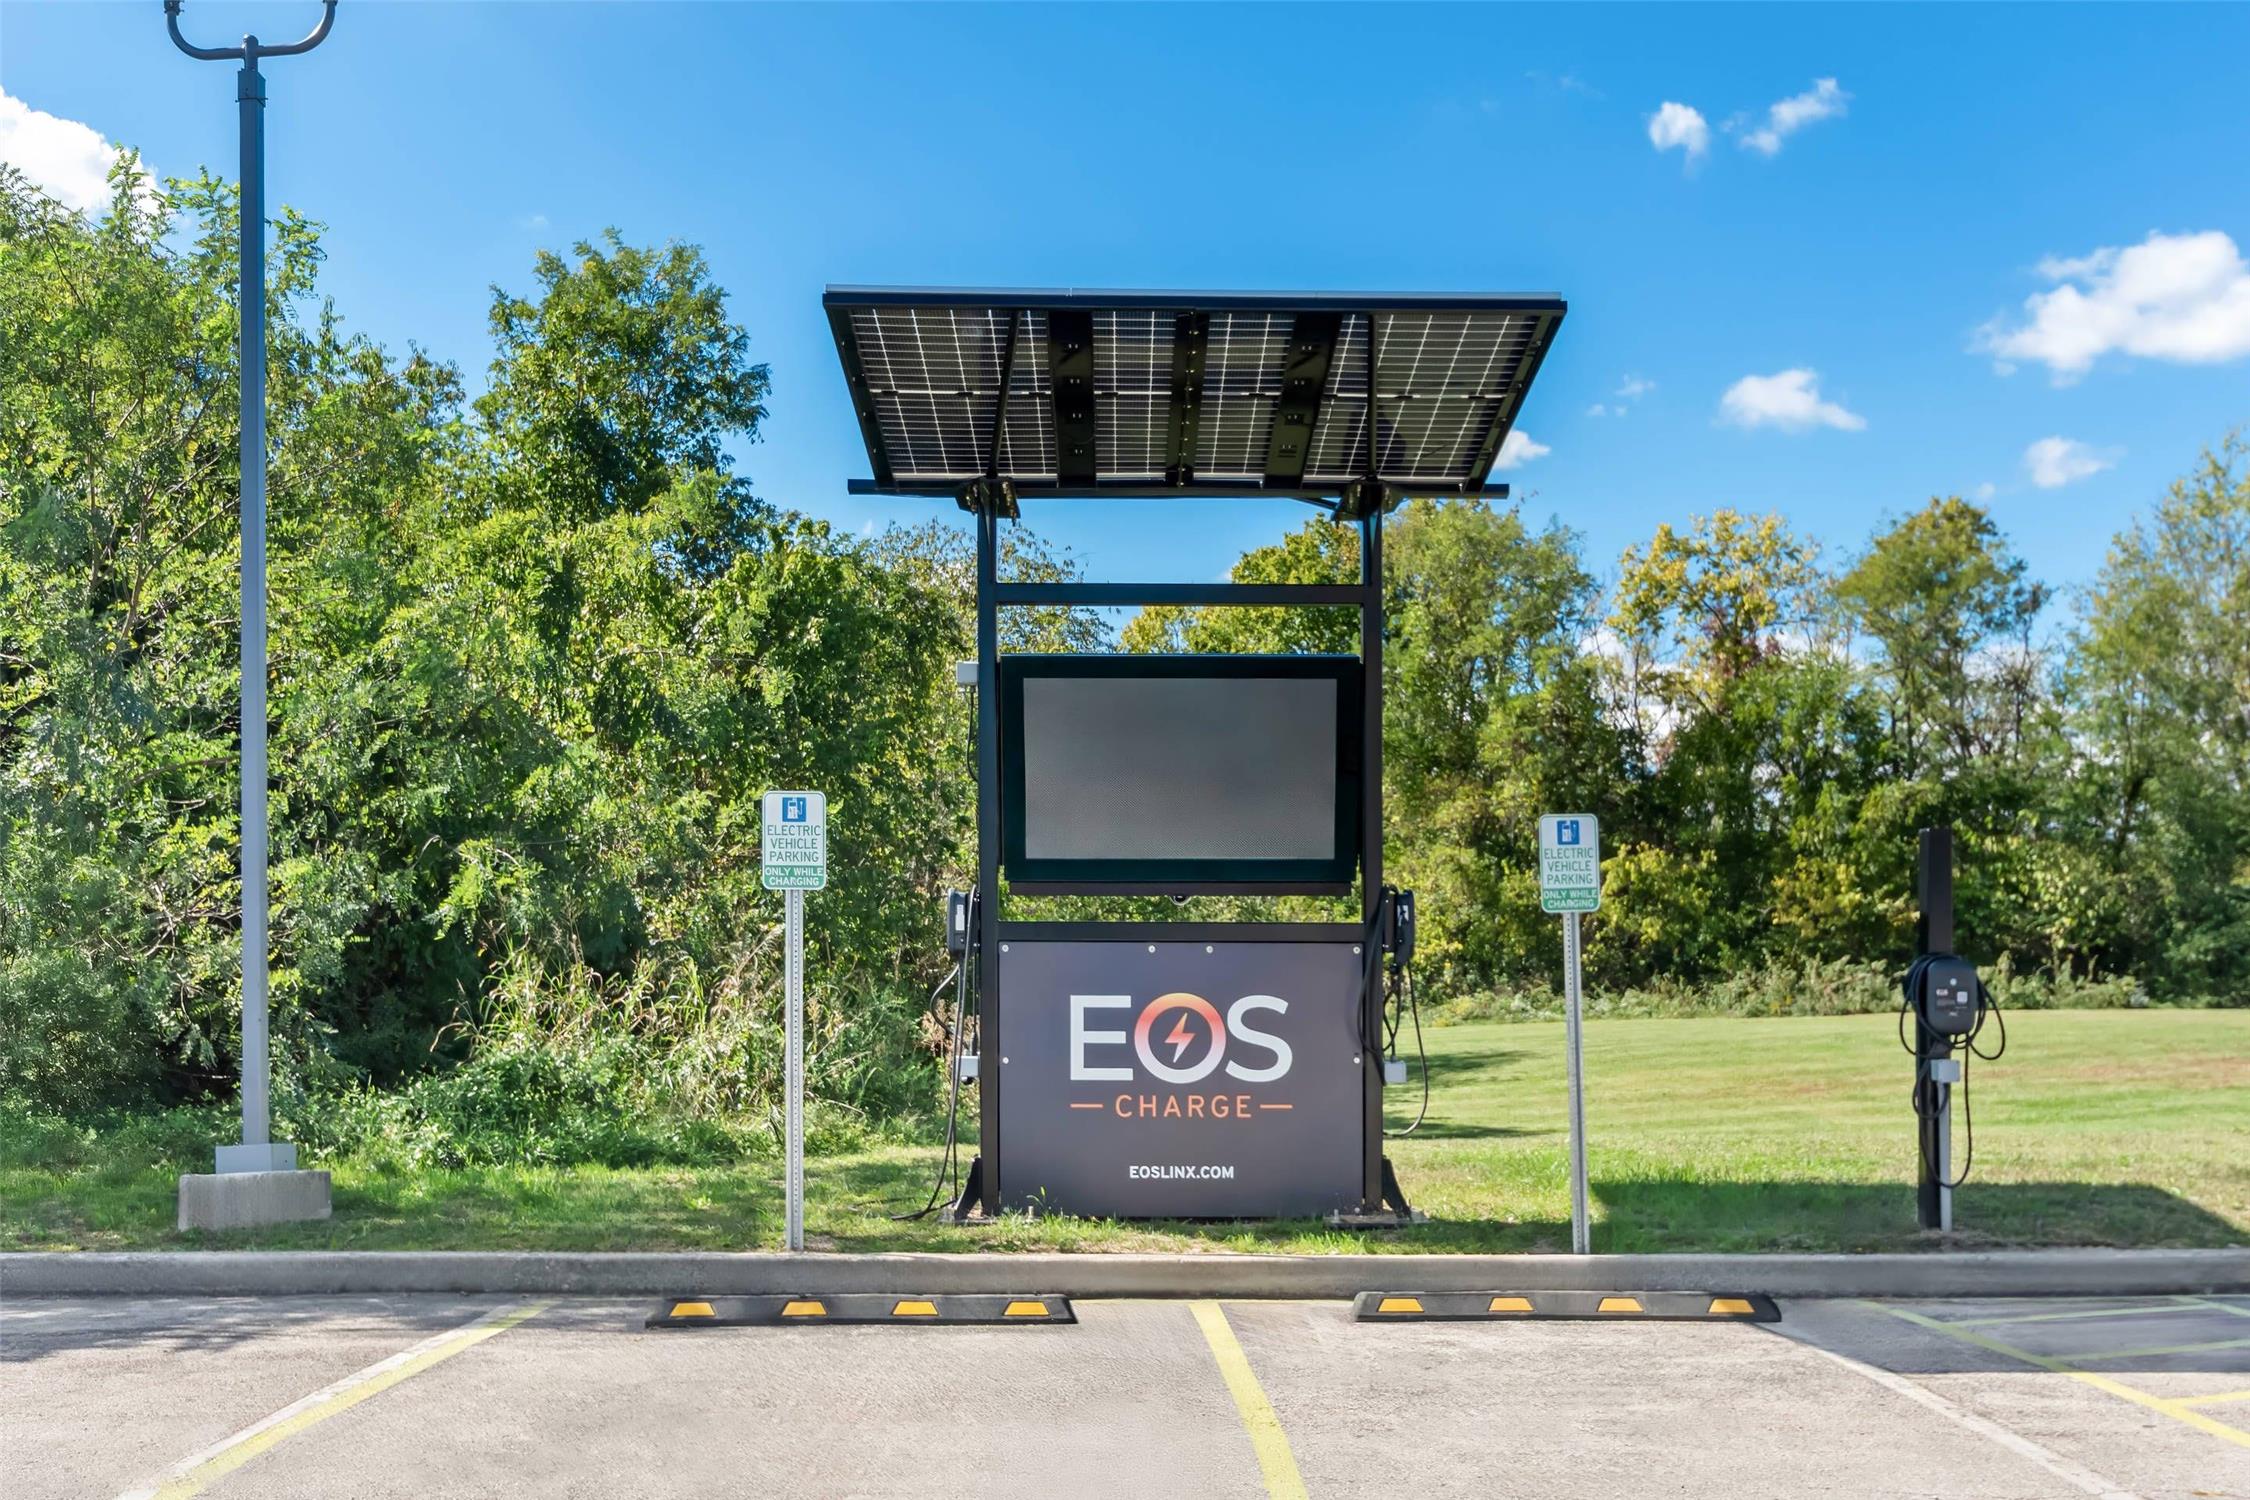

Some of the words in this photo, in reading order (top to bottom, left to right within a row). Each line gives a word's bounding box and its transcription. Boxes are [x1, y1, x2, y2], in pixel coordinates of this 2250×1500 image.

[767, 825, 821, 836] ELECTRIC
[770, 838, 818, 849] VEHICLE
[769, 851, 819, 862] PARKING
[1544, 848, 1594, 860] ELECTRIC
[765, 867, 791, 876] ONLY
[794, 867, 823, 876] WHILE
[1547, 861, 1592, 872] VEHICLE
[769, 877, 819, 886] CHARGING
[1547, 873, 1593, 885] PARKING
[1544, 890, 1568, 899] ONLY
[1570, 889, 1597, 898] WHILE
[1548, 899, 1594, 908] CHARGING
[1070, 992, 1293, 1084] EOS
[1115, 1094, 1252, 1118] CHARGE
[1129, 1165, 1235, 1179] EOSLINX.COM
